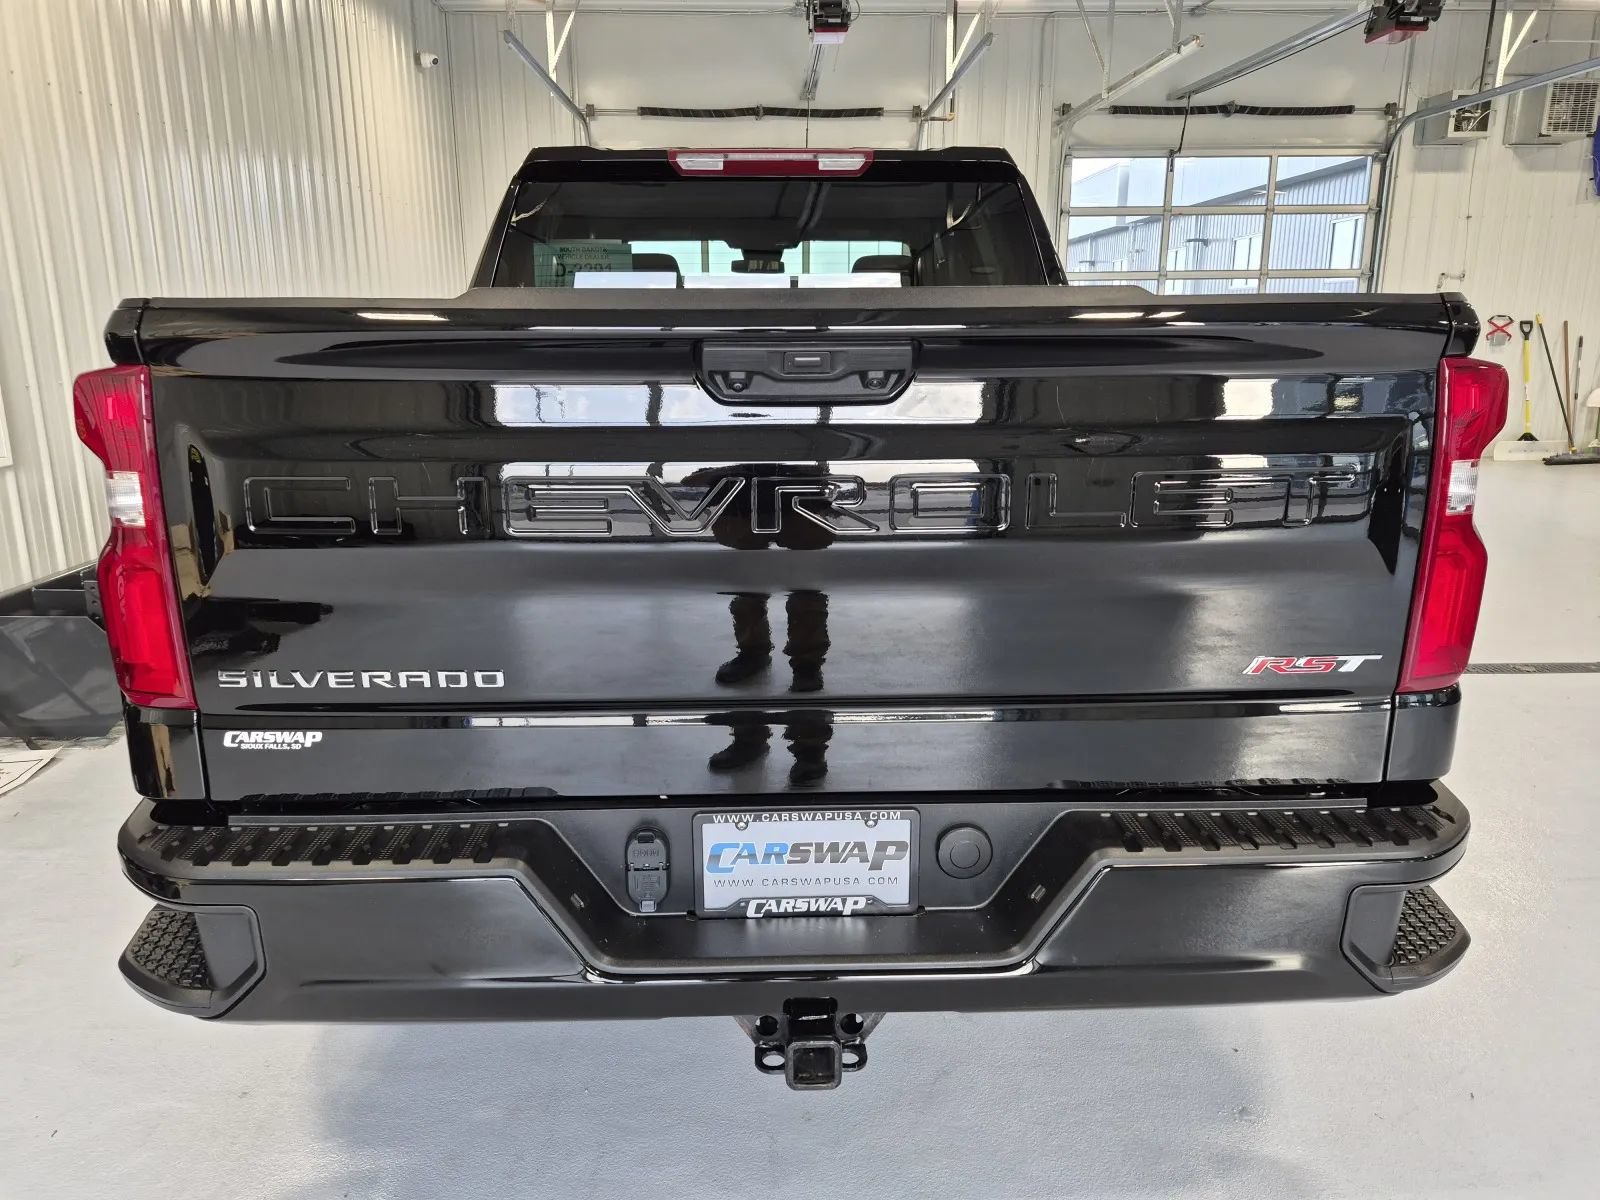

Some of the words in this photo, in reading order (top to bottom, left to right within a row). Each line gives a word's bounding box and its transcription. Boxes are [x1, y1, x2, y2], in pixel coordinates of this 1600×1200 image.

[243, 467, 1358, 537] CHEVROLET
[1242, 654, 1383, 675] RST
[217, 670, 505, 688] SILVERADO
[223, 731, 323, 748] CARSWAP
[264, 743, 290, 751] FALLS,
[713, 811, 901, 824] WWW.CARSWAPUSA.COM
[705, 840, 910, 874] CARSWAP
[713, 876, 899, 888] WWW.CARSWAPUSA.COM
[746, 897, 867, 918] CARSWAP
